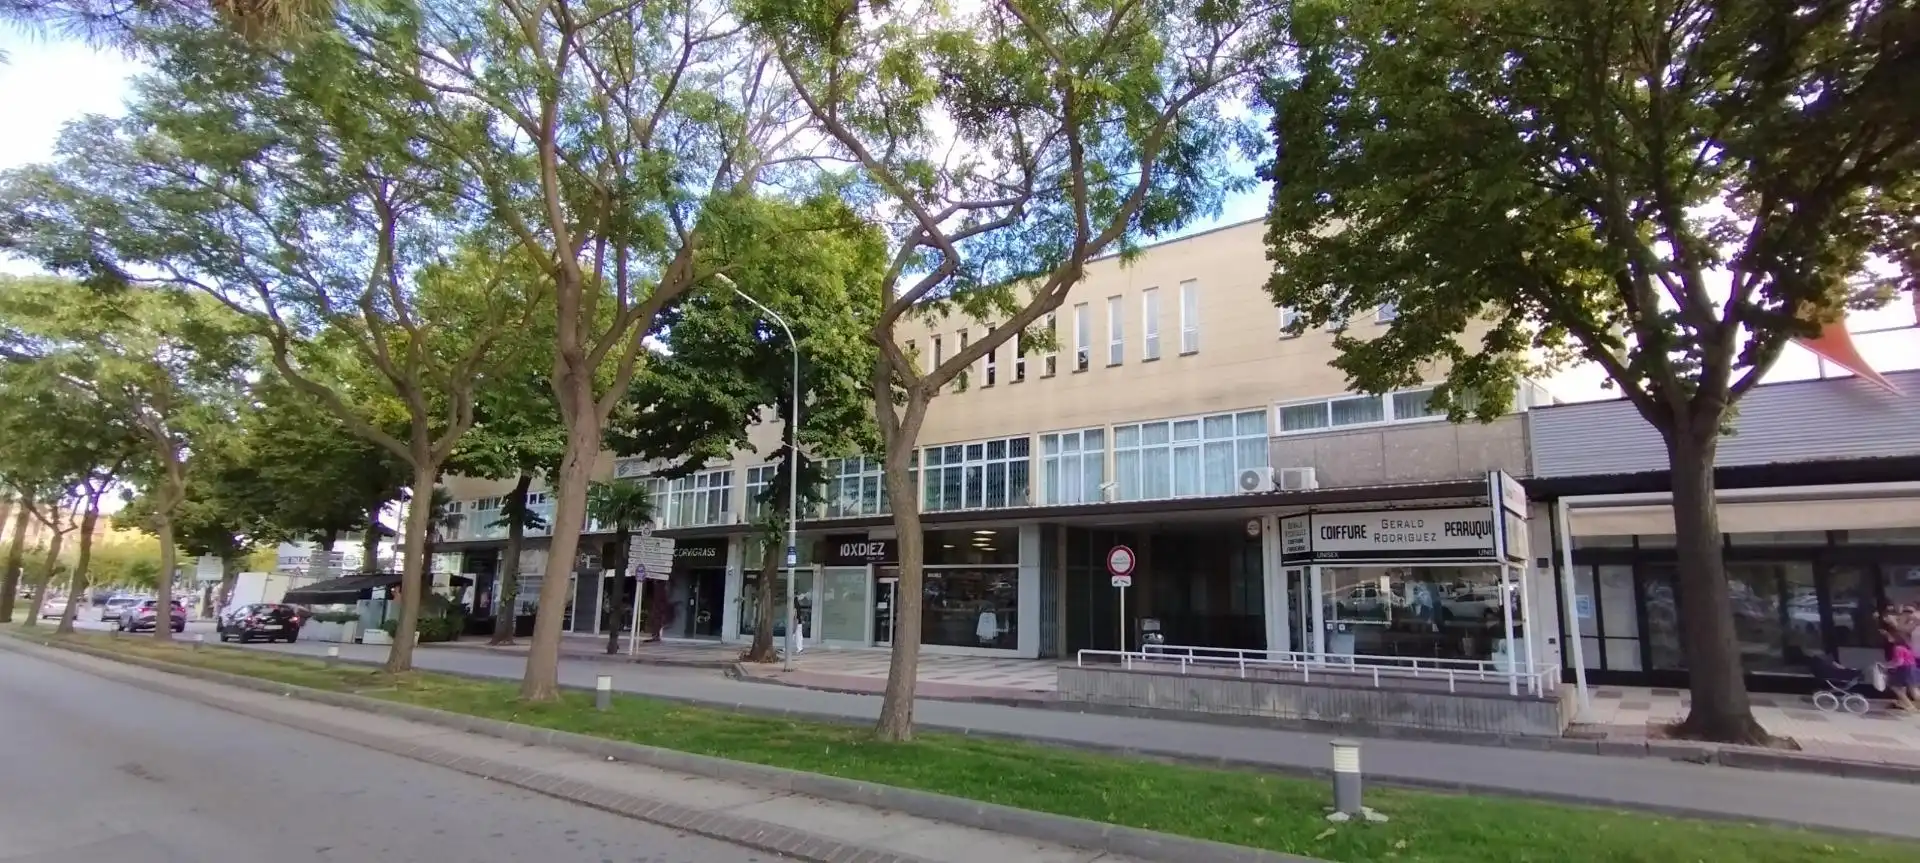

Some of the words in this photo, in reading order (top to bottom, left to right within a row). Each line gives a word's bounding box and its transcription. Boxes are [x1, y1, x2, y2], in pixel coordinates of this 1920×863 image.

[1381, 519, 1424, 529] GERALD
[1320, 524, 1368, 540] COIFFURE
[1374, 532, 1437, 543] RODRIGUEZ
